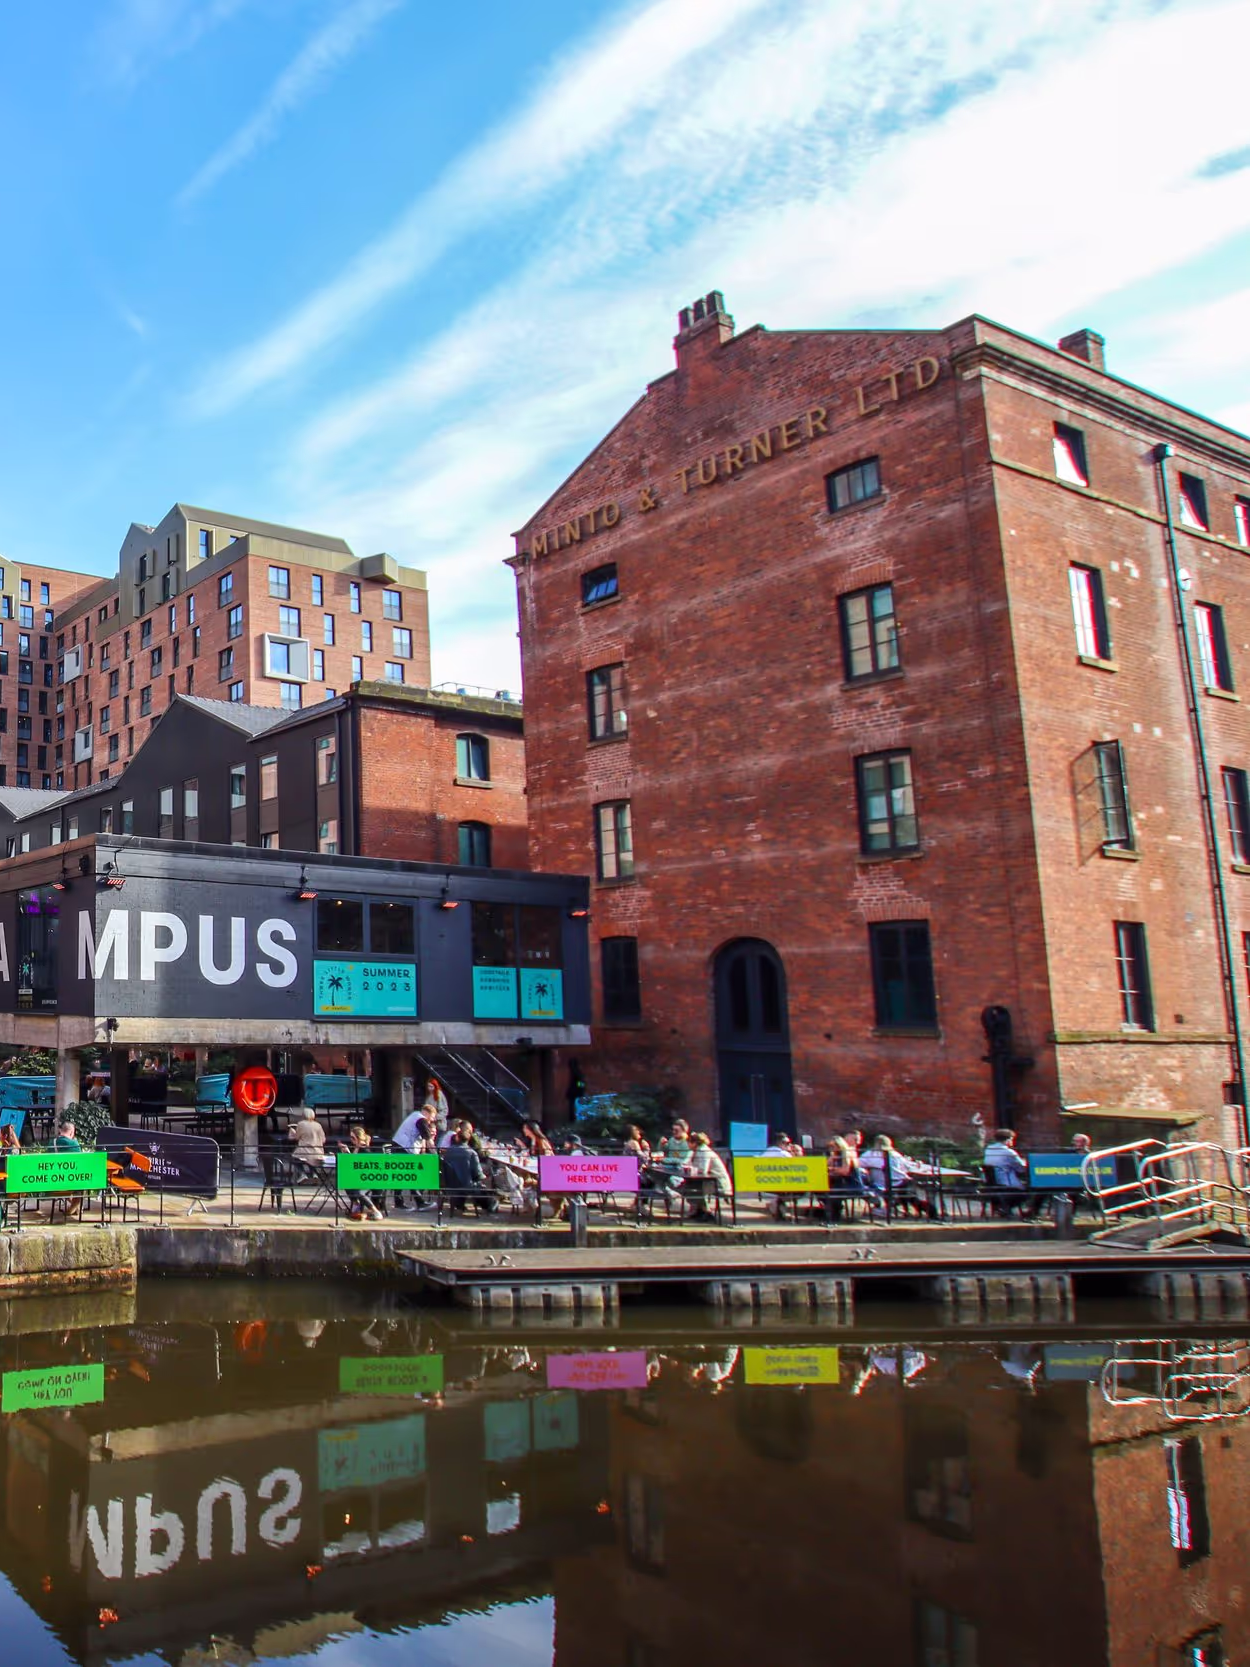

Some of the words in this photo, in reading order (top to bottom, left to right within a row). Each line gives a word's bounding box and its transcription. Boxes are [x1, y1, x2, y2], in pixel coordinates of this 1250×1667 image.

[531, 501, 621, 559] MINTO
[638, 487, 656, 512] &
[672, 406, 828, 495] TURNER
[854, 356, 941, 416] LTD
[78, 909, 298, 988] MPUS
[362, 968, 410, 978] SUMMER
[362, 981, 411, 991] 2023
[38, 1162, 56, 1171] HEY
[57, 1161, 78, 1171] YOU,
[353, 1162, 382, 1171] BEATS,
[384, 1162, 415, 1170] BOOZE
[417, 1162, 424, 1170] &
[559, 1163, 578, 1172] YOU
[581, 1163, 599, 1172] CAN
[601, 1163, 619, 1172] LIVE
[22, 1175, 49, 1184] COME
[51, 1174, 64, 1182] ON
[67, 1174, 93, 1182] OVER!
[360, 1173, 388, 1181] GOOD
[392, 1173, 418, 1181] FOOD
[567, 1175, 588, 1183] HERE
[590, 1175, 612, 1183] TOO!
[755, 1175, 782, 1183] GOOD
